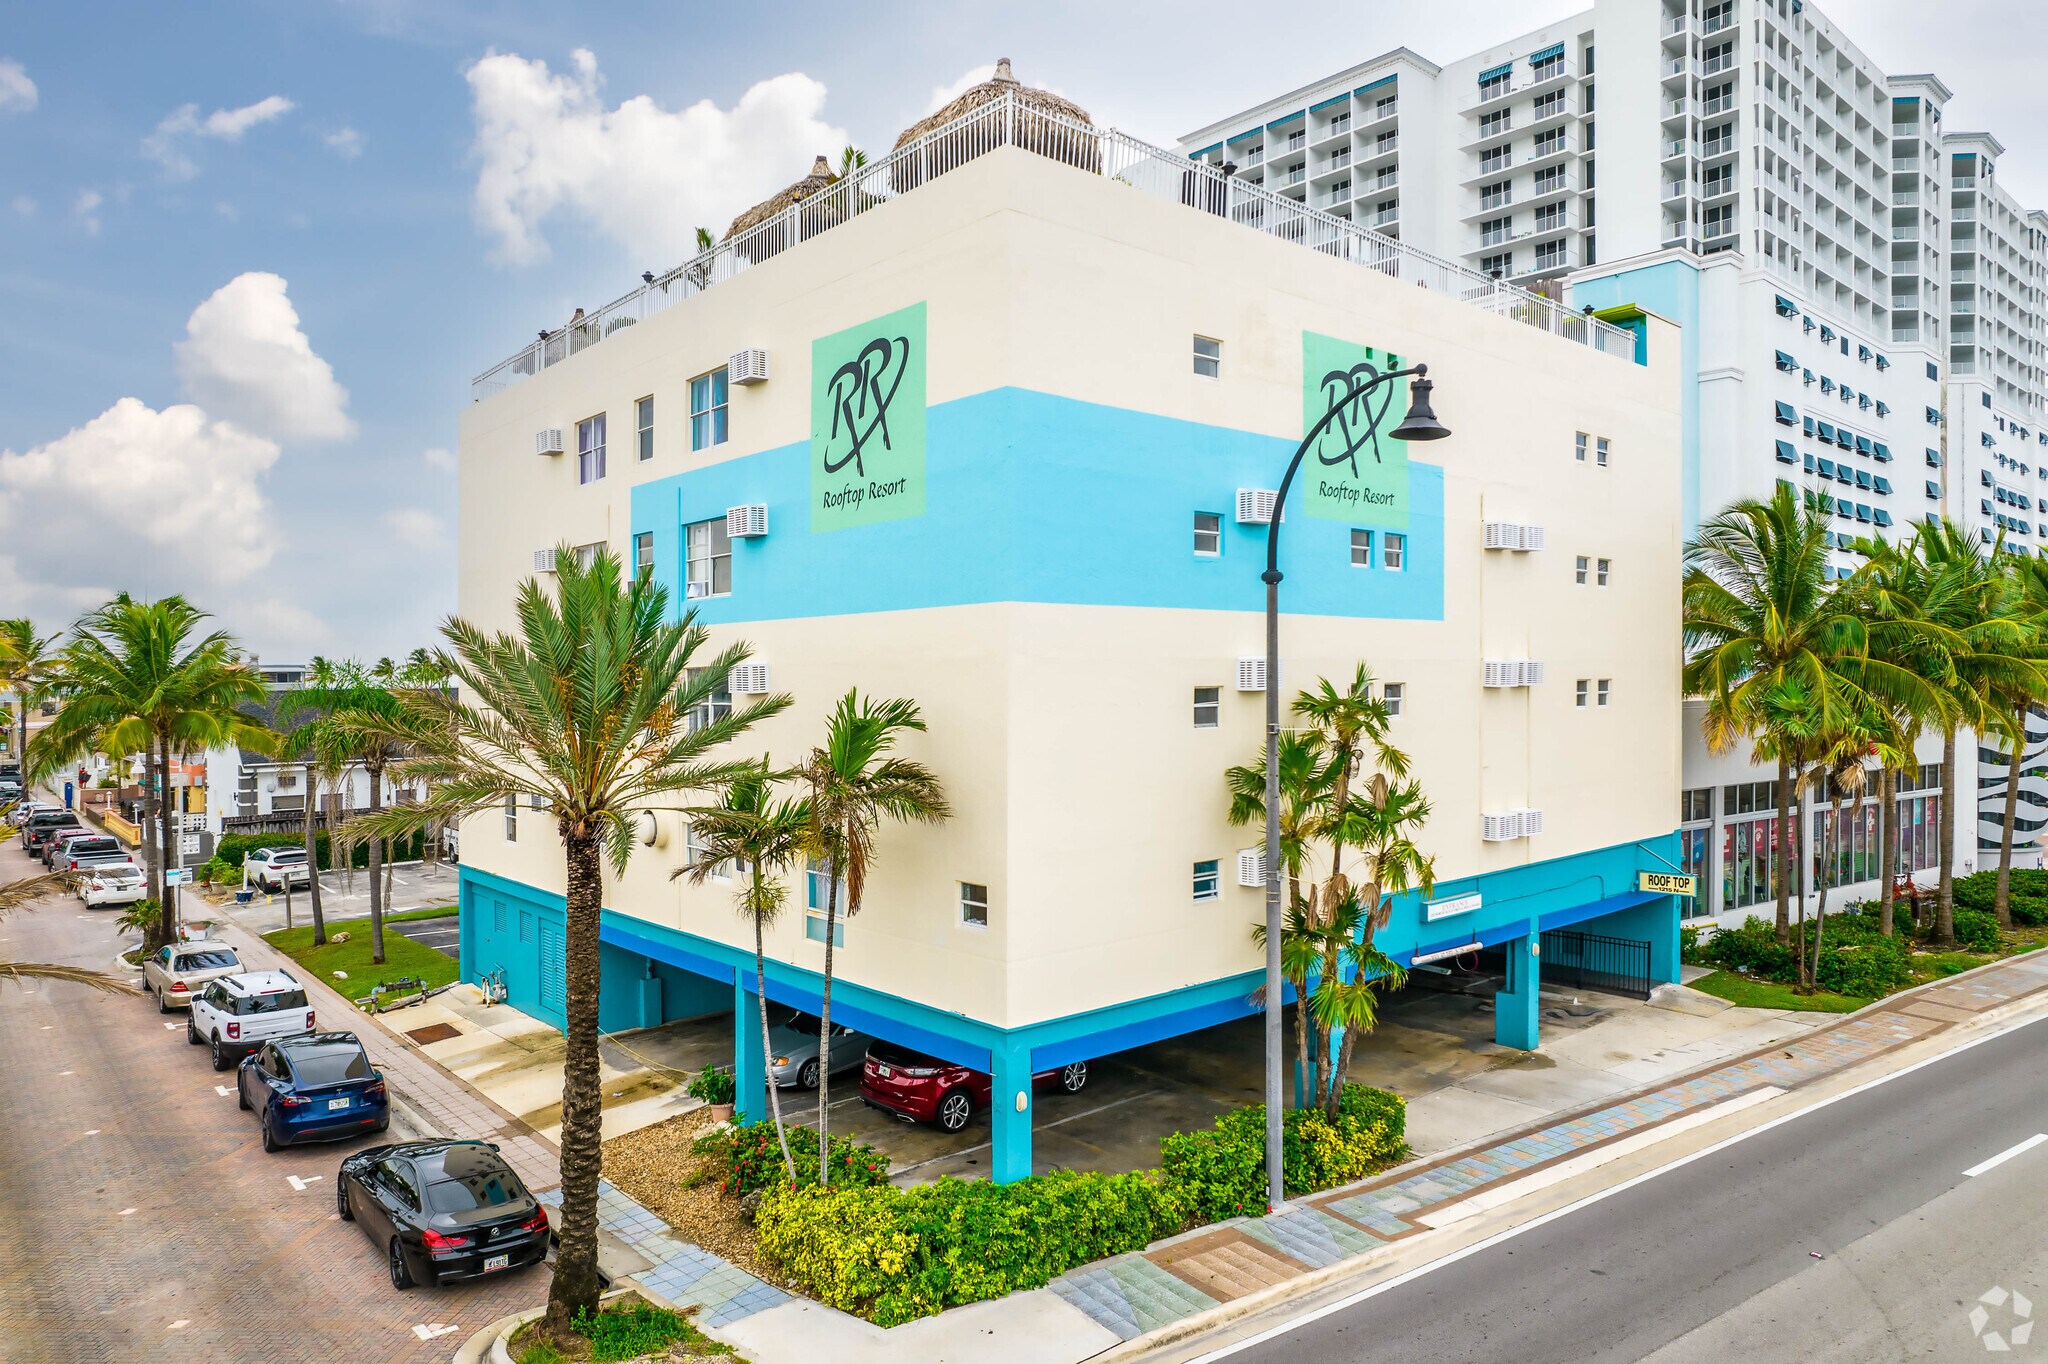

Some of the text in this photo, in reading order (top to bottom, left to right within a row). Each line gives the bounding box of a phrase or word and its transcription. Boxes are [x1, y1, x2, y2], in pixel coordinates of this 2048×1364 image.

[823, 477, 906, 511] Rooftop Resort
[1319, 481, 1395, 507] Rooftop Resort
[1648, 874, 1690, 889] ROOF TOP
